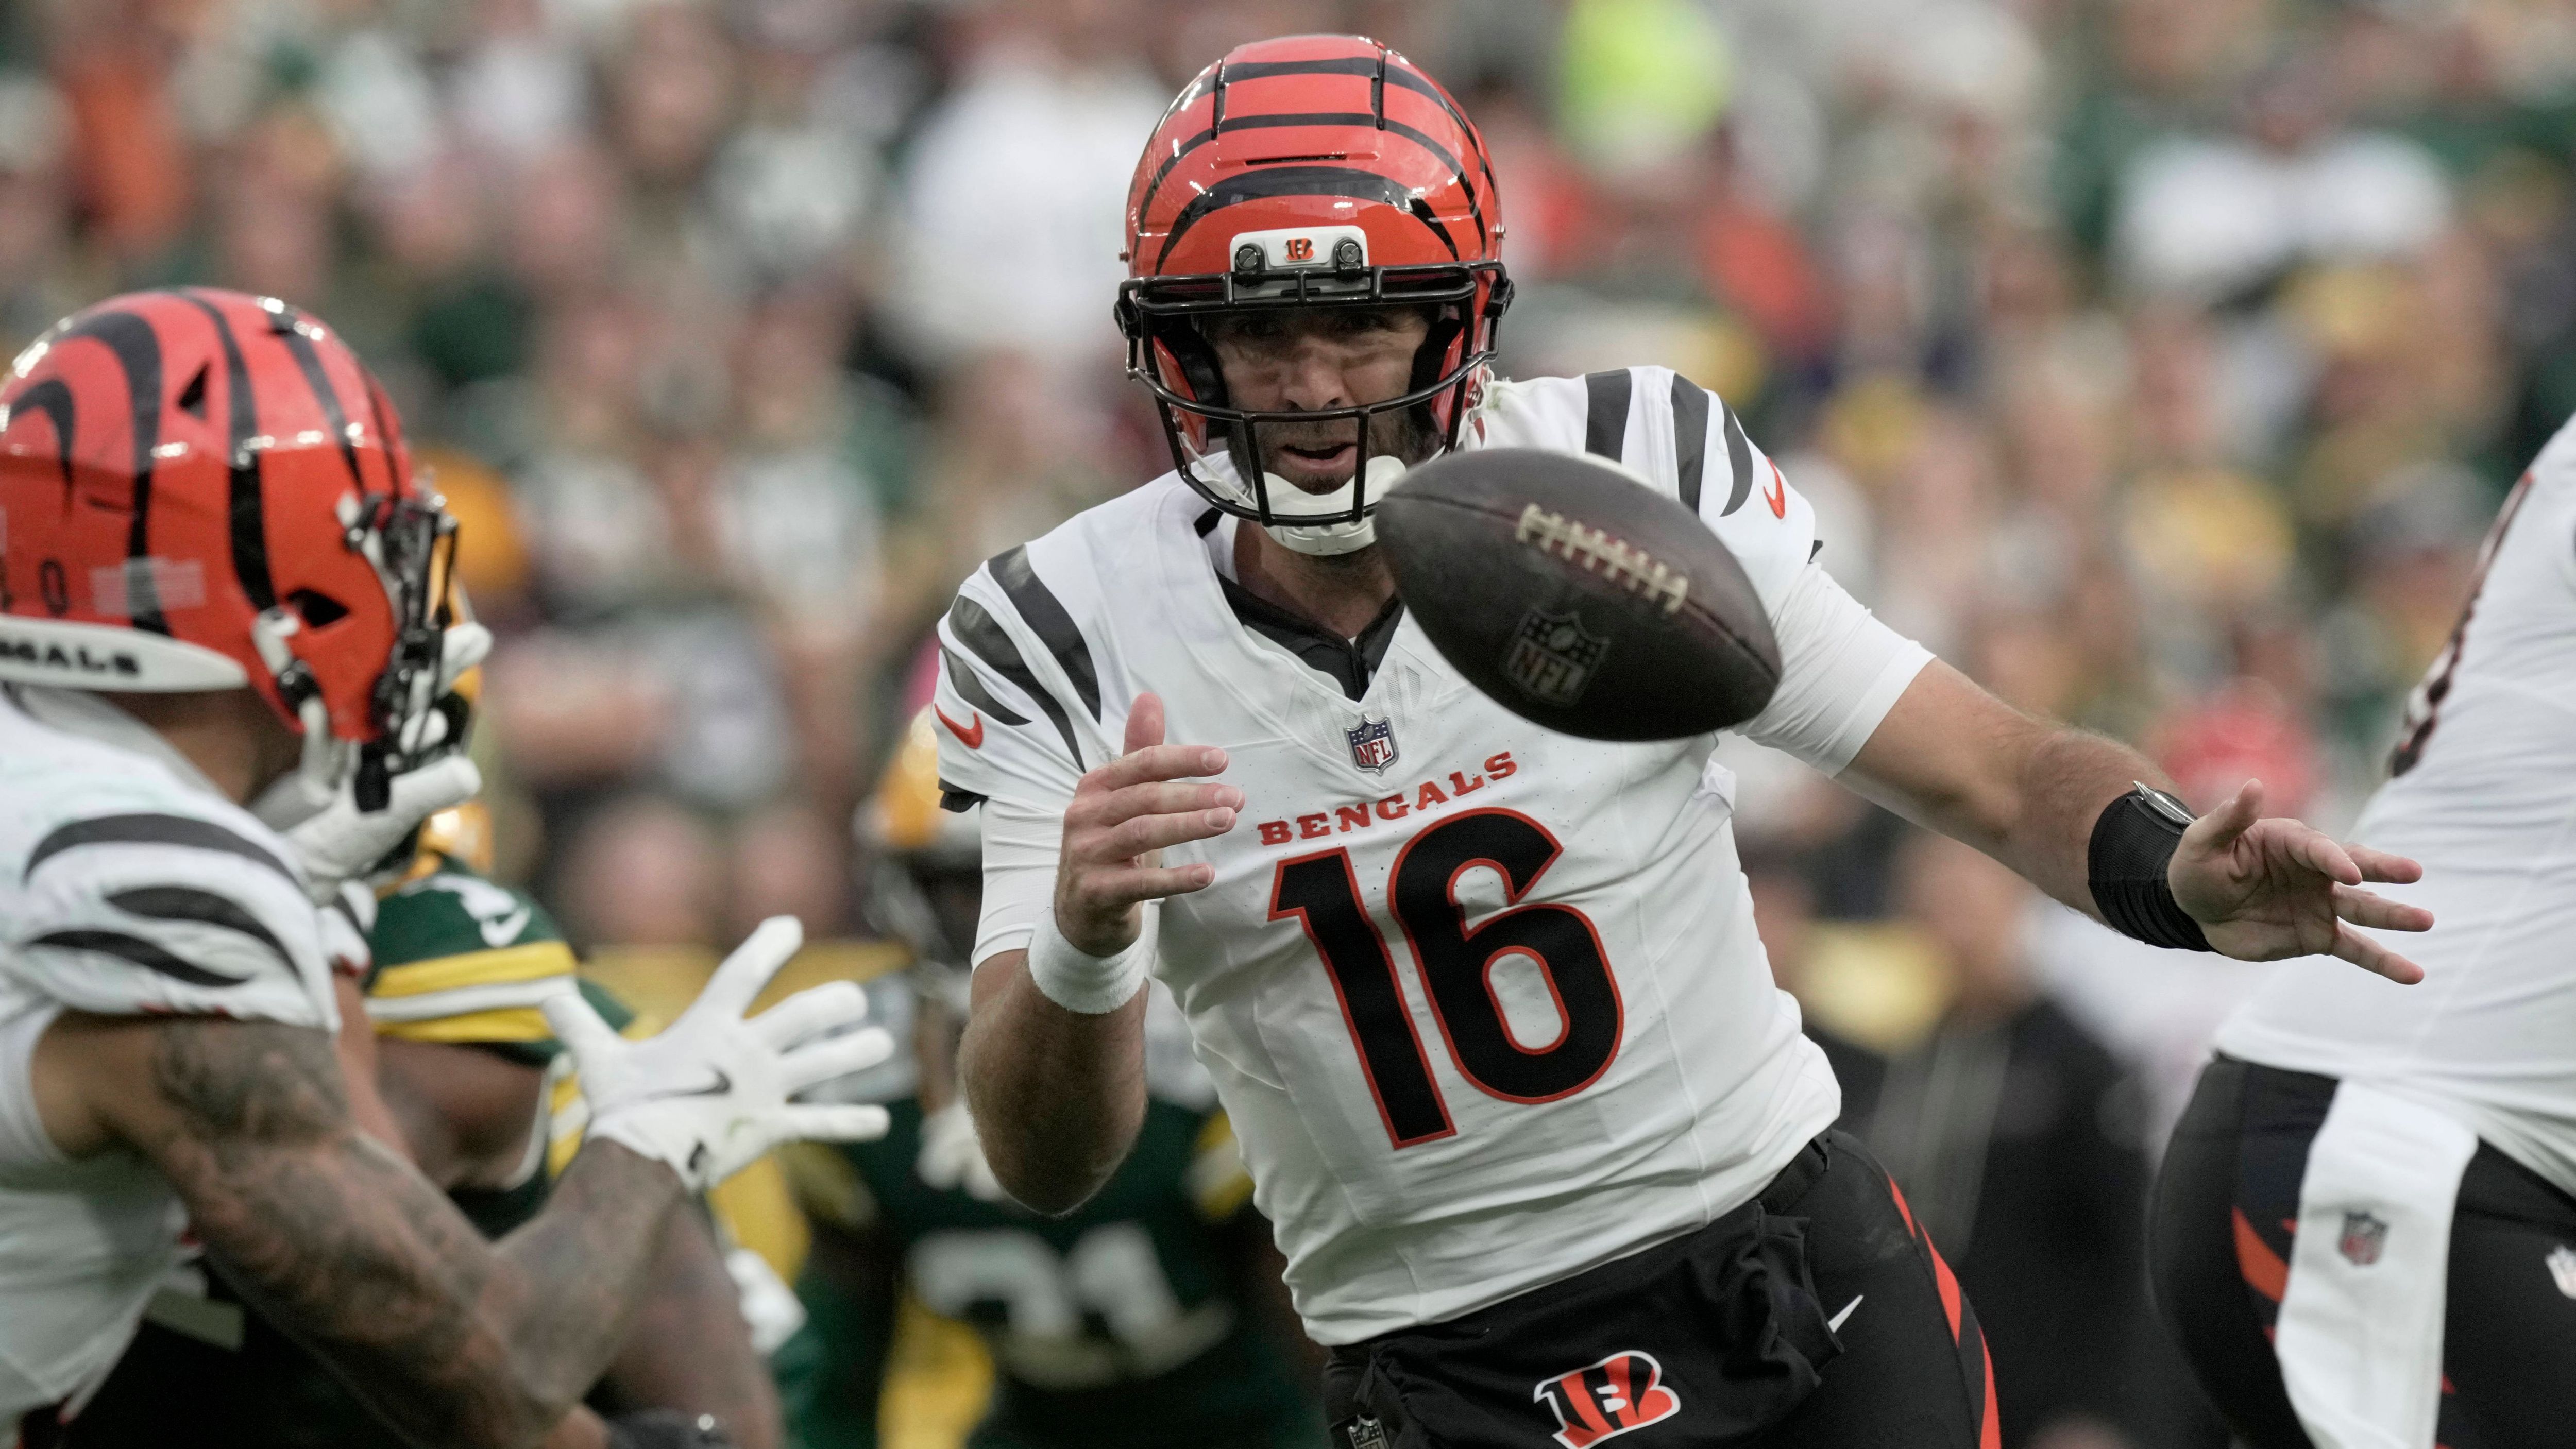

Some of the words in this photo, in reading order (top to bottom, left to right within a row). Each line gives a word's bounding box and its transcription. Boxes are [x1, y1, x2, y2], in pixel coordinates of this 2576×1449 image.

[1512, 647, 1573, 696] NFL
[1357, 740, 1391, 764] NFL
[1257, 751, 1518, 846] BENGALS
[1267, 806, 1624, 1150] 16
